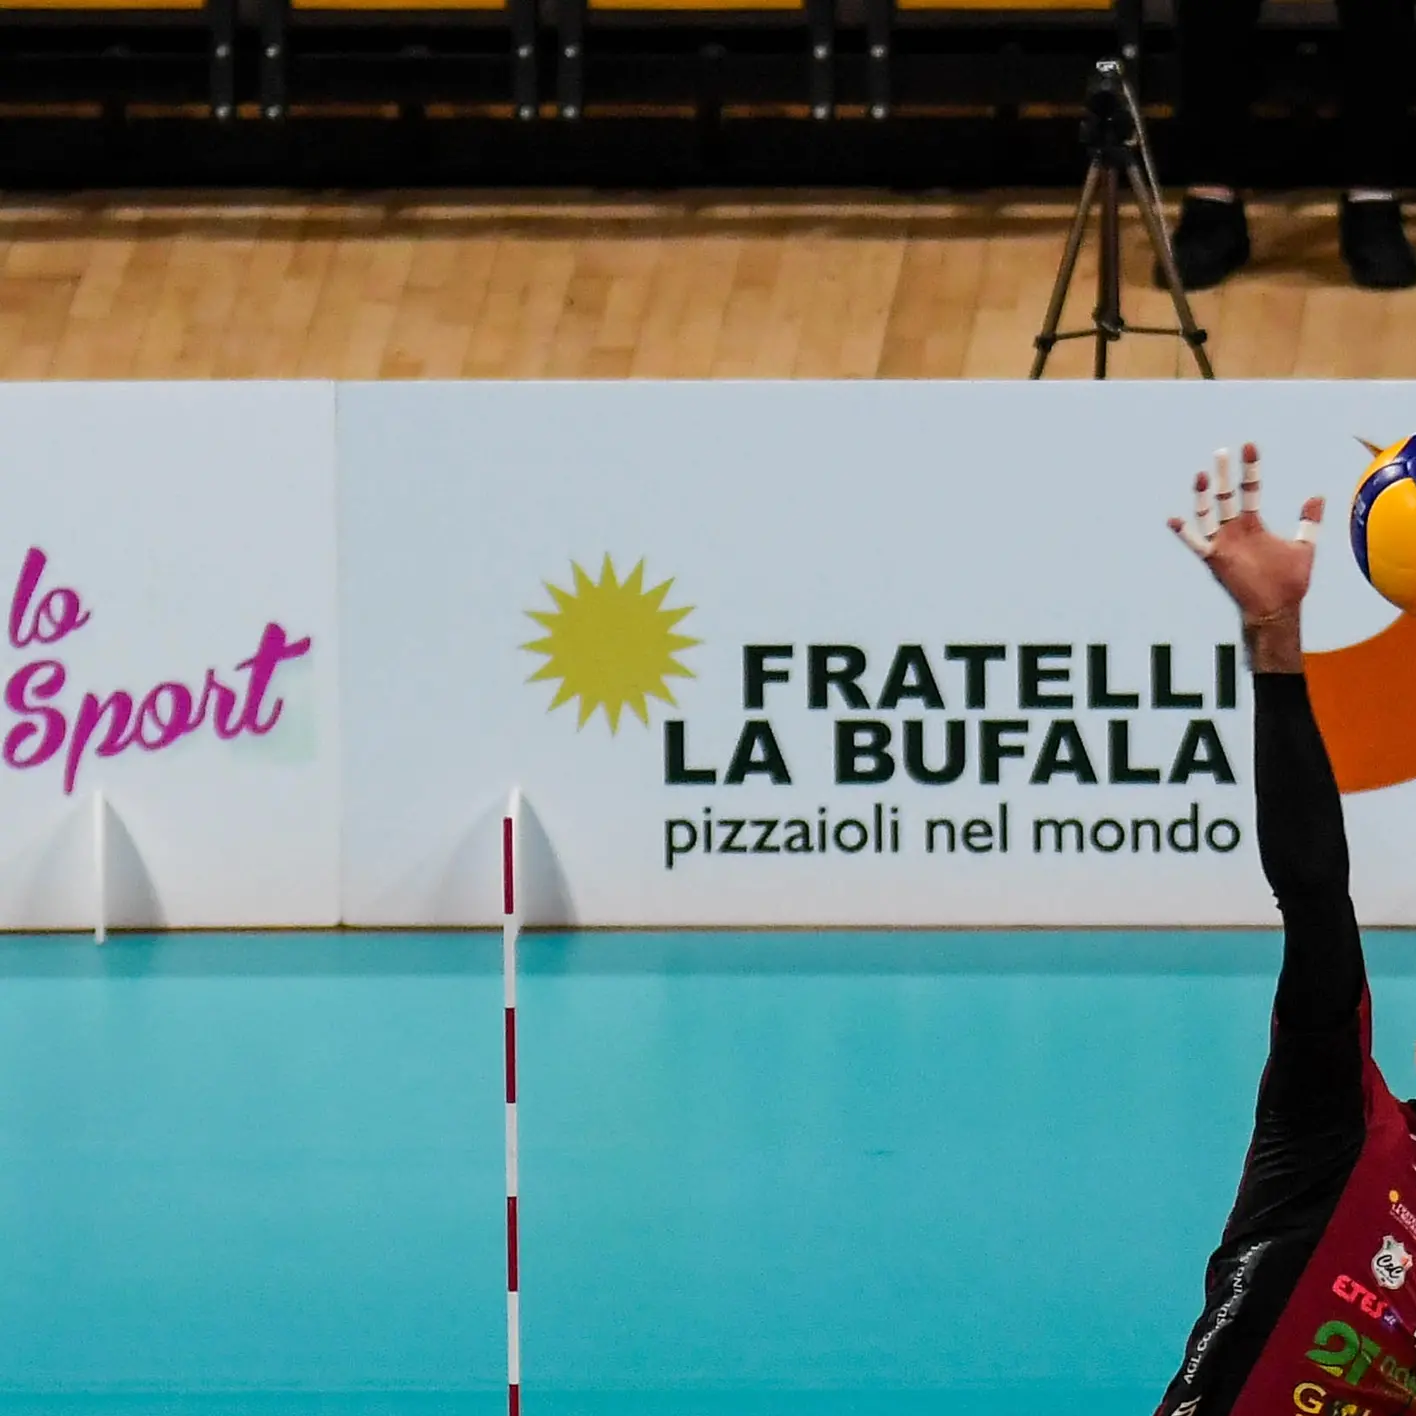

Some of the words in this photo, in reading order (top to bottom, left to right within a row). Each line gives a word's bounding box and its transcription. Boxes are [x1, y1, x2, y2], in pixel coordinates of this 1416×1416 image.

[8, 547, 91, 649] lo
[3, 622, 311, 795] Sport
[743, 644, 1237, 710] FRATELLI
[664, 719, 792, 785] LA
[834, 719, 1237, 785] BUFALA
[664, 803, 900, 869] pizzaioli
[925, 803, 1009, 854] nel
[1032, 803, 1241, 854] mondo
